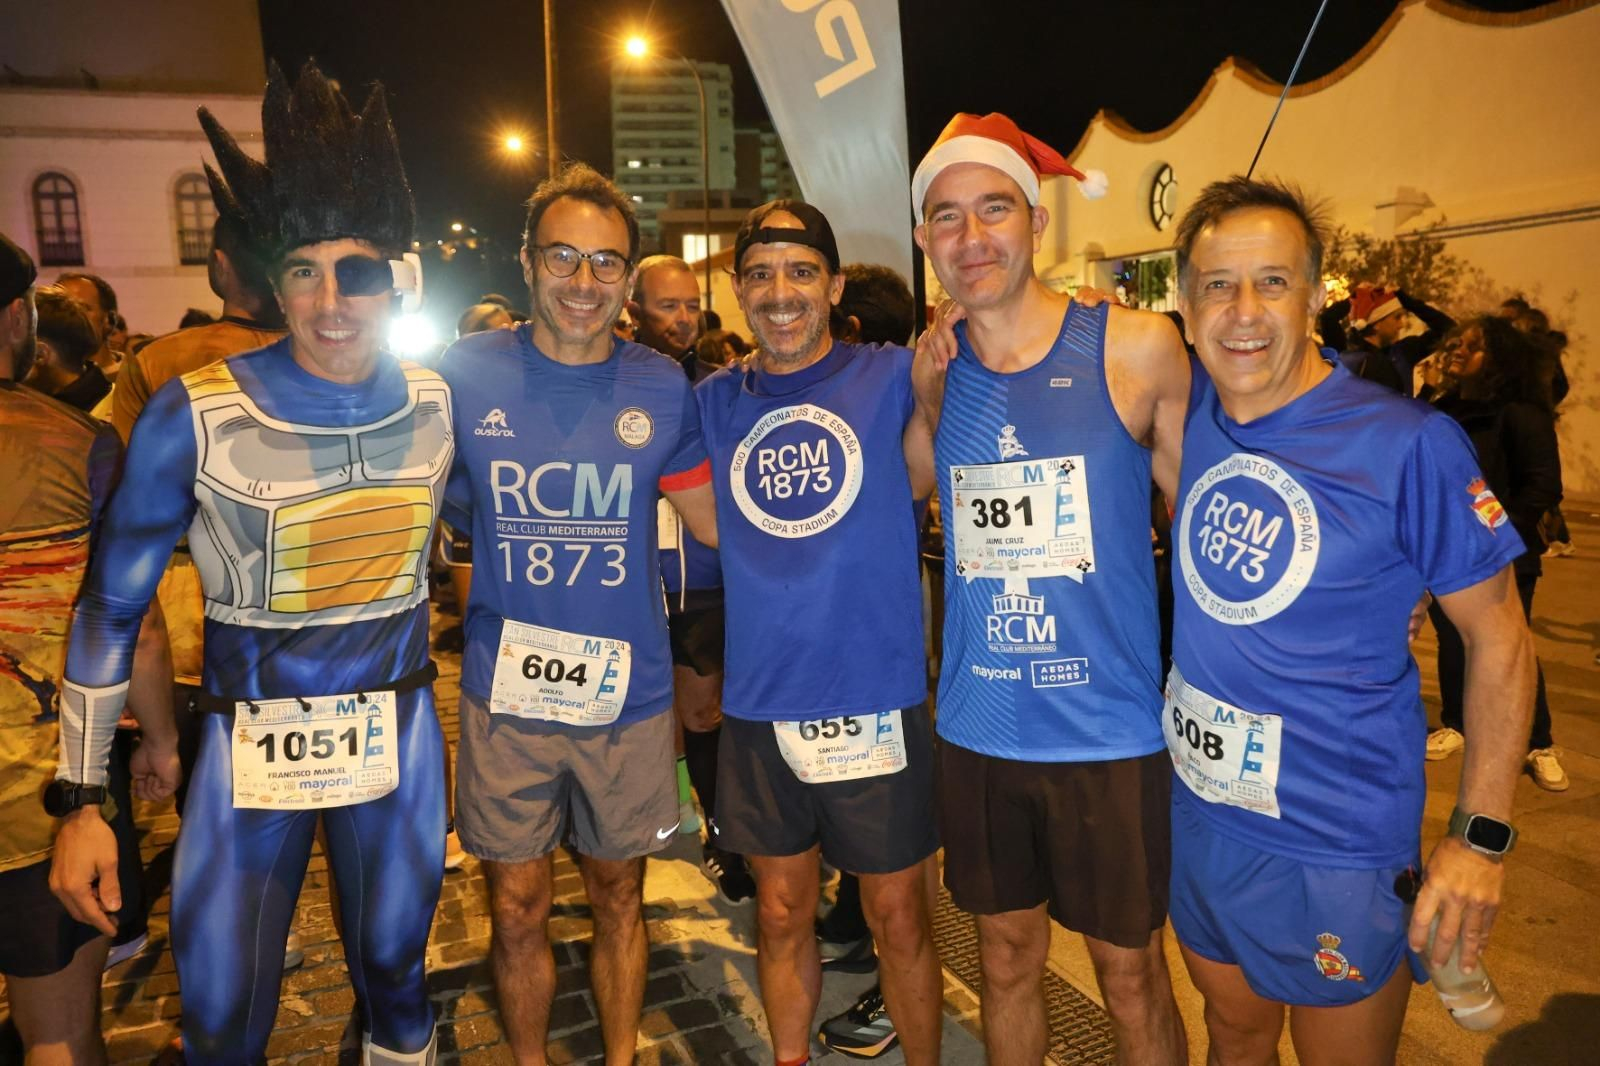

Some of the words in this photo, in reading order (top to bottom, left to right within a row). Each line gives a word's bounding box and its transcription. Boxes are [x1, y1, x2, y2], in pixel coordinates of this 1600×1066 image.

[744, 407, 809, 449] CAMPEONATOS
[812, 410, 828, 422] DE
[828, 419, 857, 456] ESPAÑA
[758, 438, 829, 475] RCM
[490, 459, 633, 518] RCM
[757, 465, 832, 500] 1873
[762, 518, 788, 534] COPA
[791, 508, 839, 534] STADIUM
[971, 495, 1033, 528] 381
[1204, 491, 1284, 550] RCM
[1280, 478, 1298, 498] DE
[1293, 498, 1316, 553] ESPAÑA
[496, 522, 518, 534] REAL
[521, 524, 546, 535] CLUB
[548, 525, 629, 536] MEDITERRANEO
[986, 537, 1003, 545] JAIME
[1005, 536, 1024, 545] CRUZ
[497, 541, 627, 587] 1873
[997, 544, 1046, 559] mayoral
[1197, 525, 1270, 583] 1873
[1188, 574, 1207, 603] COPA
[1208, 599, 1259, 620] STADIUM
[987, 615, 1057, 643] RCM
[522, 654, 587, 687] 604
[972, 664, 1021, 680] mayoral
[1041, 663, 1080, 674] AEDAS
[1041, 672, 1080, 682] HOMES
[538, 688, 564, 696] ADOLFO
[542, 695, 586, 709] mayoral
[799, 717, 862, 741] 655
[1173, 706, 1224, 761] 608
[257, 727, 358, 763] 1051
[817, 745, 849, 754] SANTIAGO
[827, 751, 870, 765] mayoral
[267, 770, 311, 779] FRANCISCO
[313, 766, 347, 776] MANUEL
[299, 775, 352, 790] mayoral
[1187, 763, 1229, 791] mayoral
